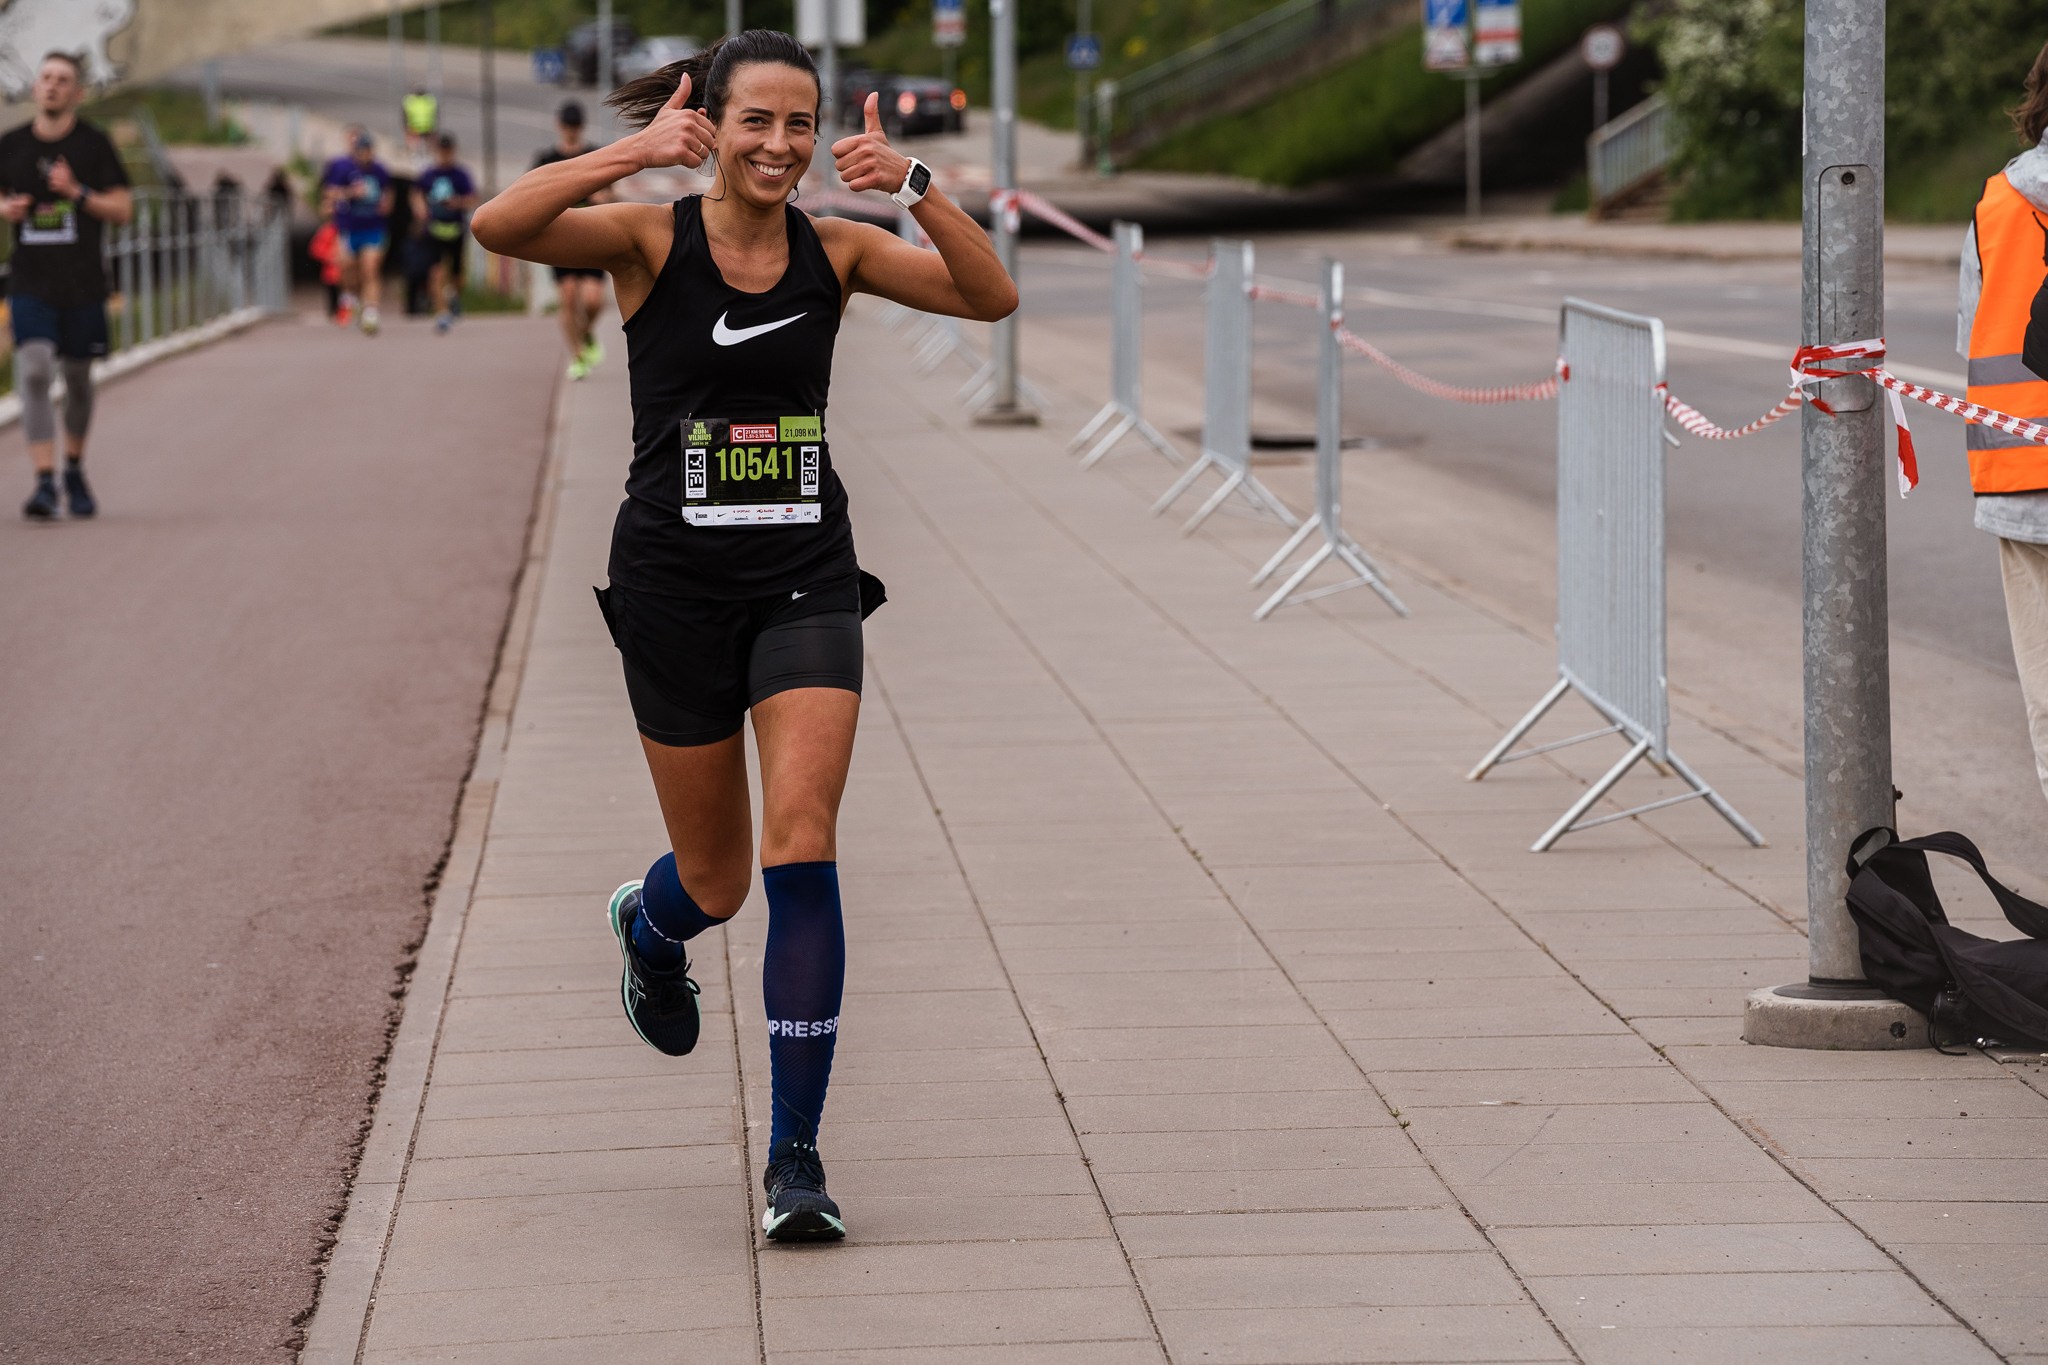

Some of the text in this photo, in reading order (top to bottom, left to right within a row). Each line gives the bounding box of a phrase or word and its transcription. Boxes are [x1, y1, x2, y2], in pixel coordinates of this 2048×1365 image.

[735, 430, 743, 439] C
[785, 428, 817, 438] 21,098 KM
[715, 447, 793, 481] 10541
